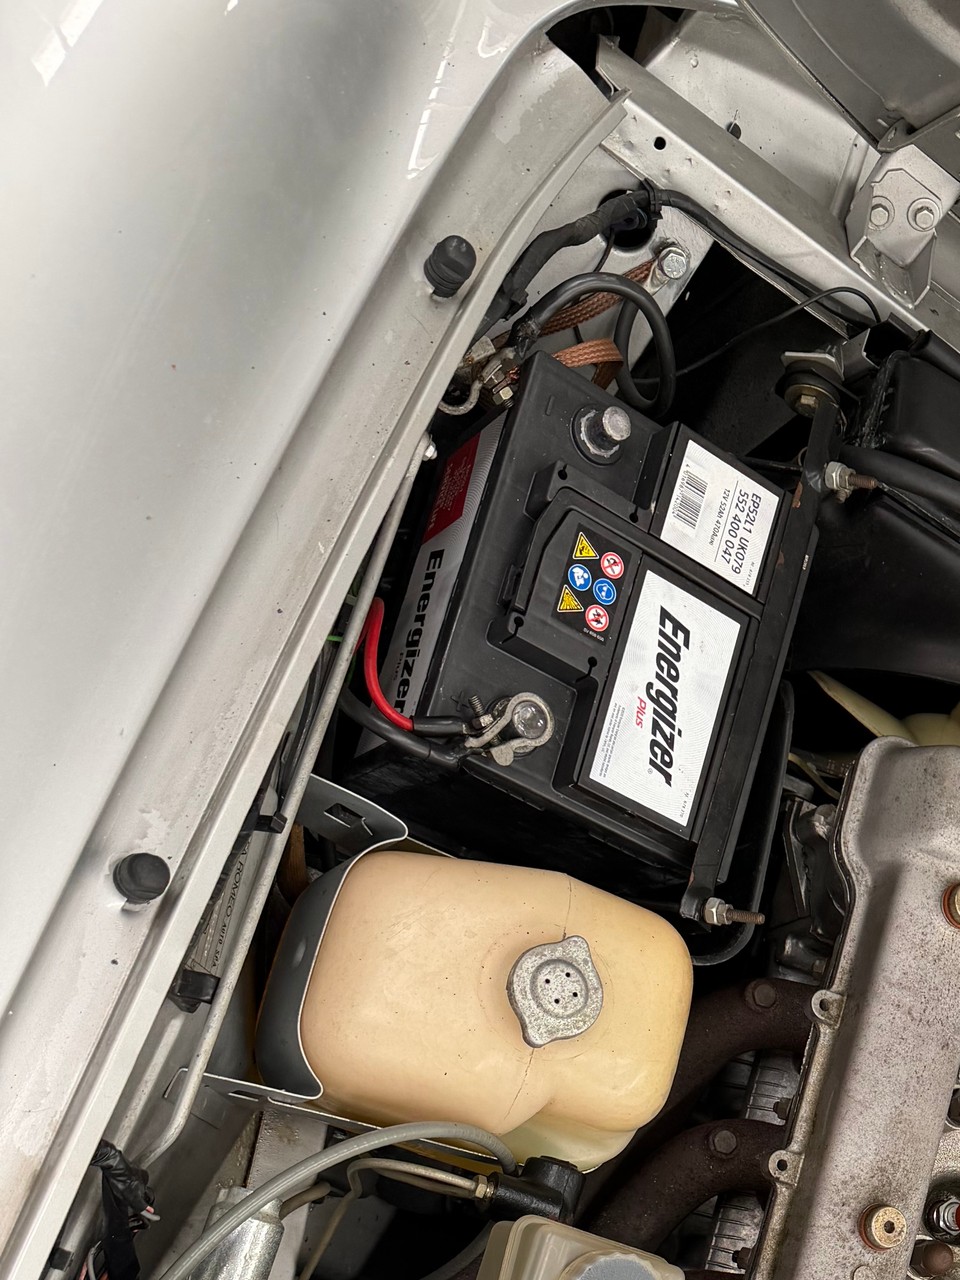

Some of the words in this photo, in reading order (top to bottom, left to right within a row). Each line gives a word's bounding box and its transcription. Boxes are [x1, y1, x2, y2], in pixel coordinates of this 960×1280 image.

[718, 501, 726, 518] 52Ah
[735, 489, 749, 513] 552
[748, 493, 761, 534] EP52L1
[728, 513, 742, 538] 400
[721, 539, 735, 564] 047
[732, 537, 749, 575] UK079
[395, 549, 445, 713] Energizer
[646, 606, 690, 787] Energizer
[226, 862, 244, 917] ROMEO
